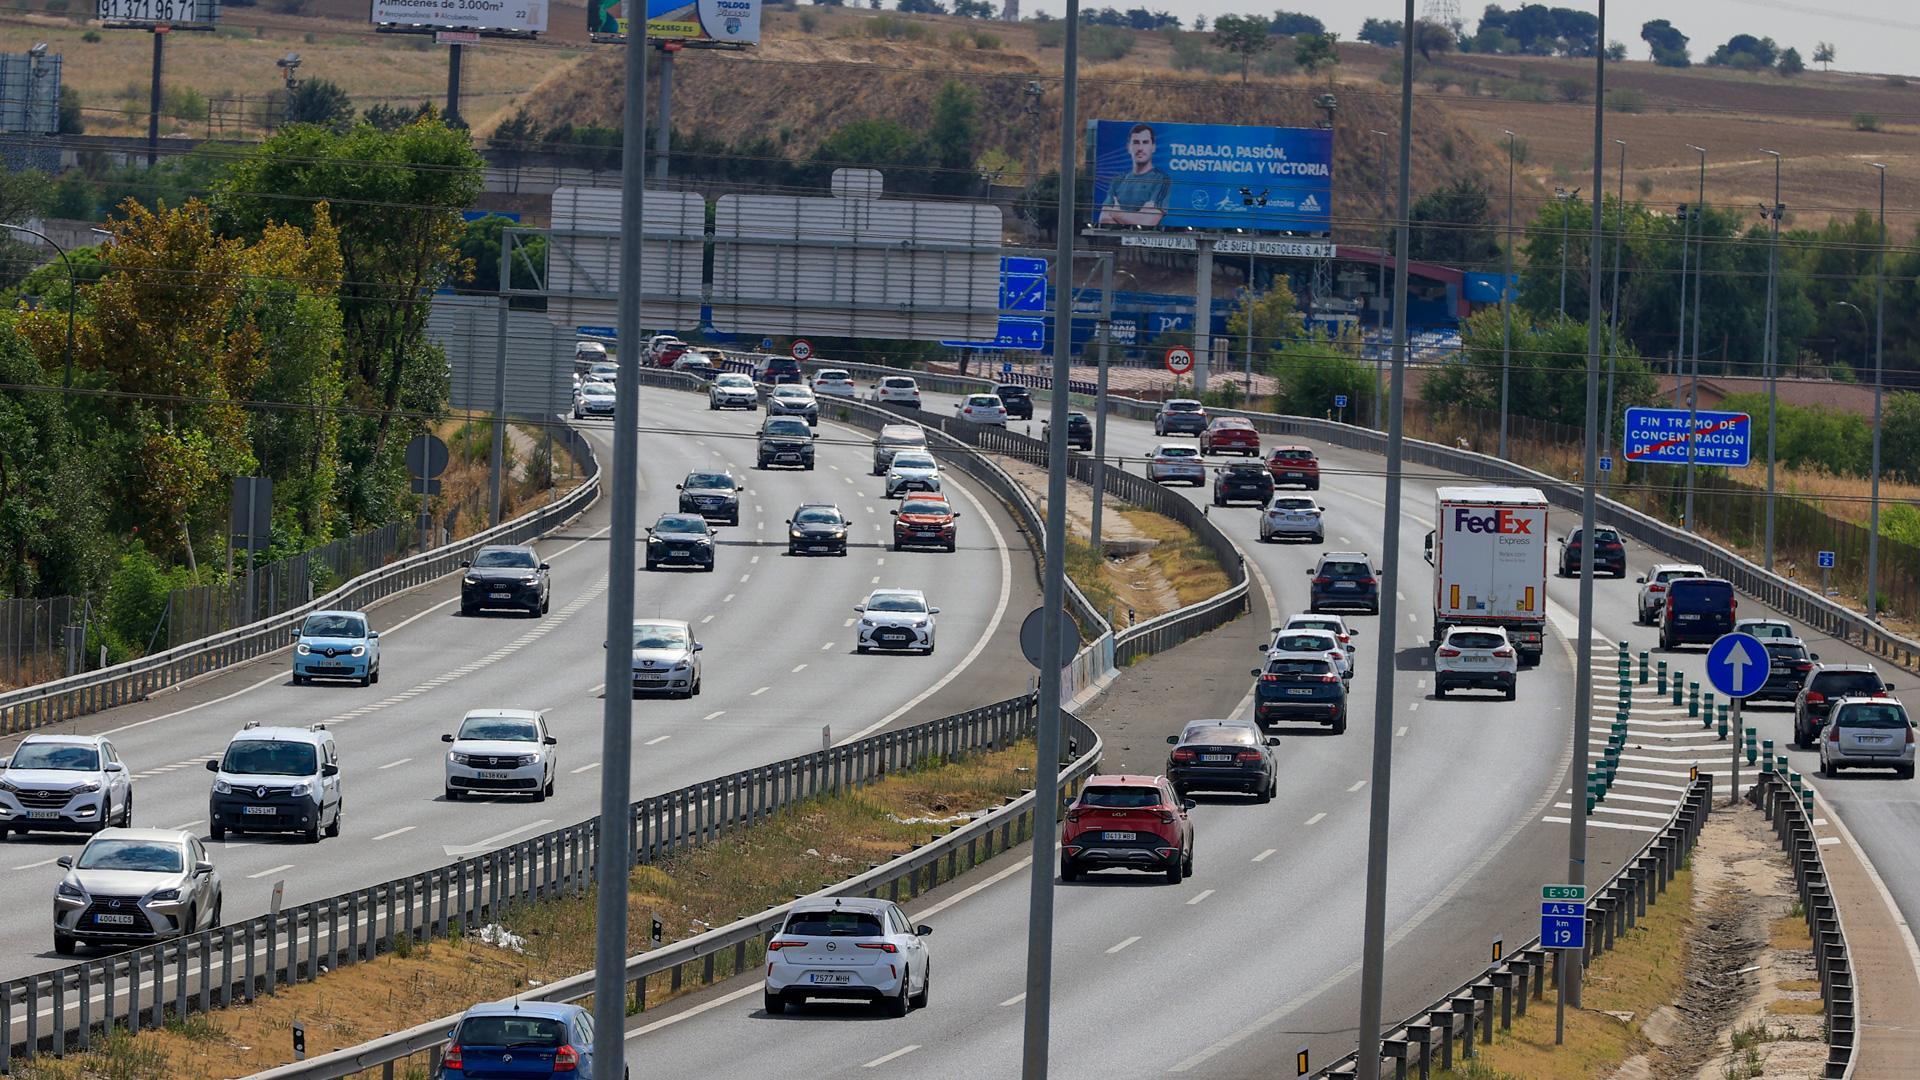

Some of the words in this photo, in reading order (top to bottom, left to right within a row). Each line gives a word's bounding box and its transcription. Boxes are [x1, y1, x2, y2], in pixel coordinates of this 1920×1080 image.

[379, 0, 438, 8] Almacenes
[440, 0, 455, 8] de
[717, 1, 750, 9] TOLDOS
[101, 0, 117, 18] 91
[124, 0, 148, 19] 371
[155, 0, 173, 20] 96
[179, 0, 195, 20] 71
[1170, 144, 1234, 159] TRABAJO,
[1236, 144, 1287, 160] PASIÓN,
[1169, 158, 1254, 173] CONSTANCIA
[1257, 161, 1266, 174] Y
[1267, 162, 1329, 176] VICTORIA
[1170, 355, 1189, 365] 120
[1640, 416, 1660, 427] FIN
[1667, 417, 1713, 430] TRAMO
[1719, 420, 1736, 430] DE
[1634, 444, 1650, 455] DE
[1455, 508, 1532, 535] FedEx
[1499, 536, 1530, 546] Express
[1549, 888, 1578, 897] E-90
[99, 914, 116, 923] 4004
[118, 915, 132, 924] LCS
[1556, 919, 1569, 927] km
[1554, 930, 1571, 943] 19
[815, 974, 834, 983] 7577
